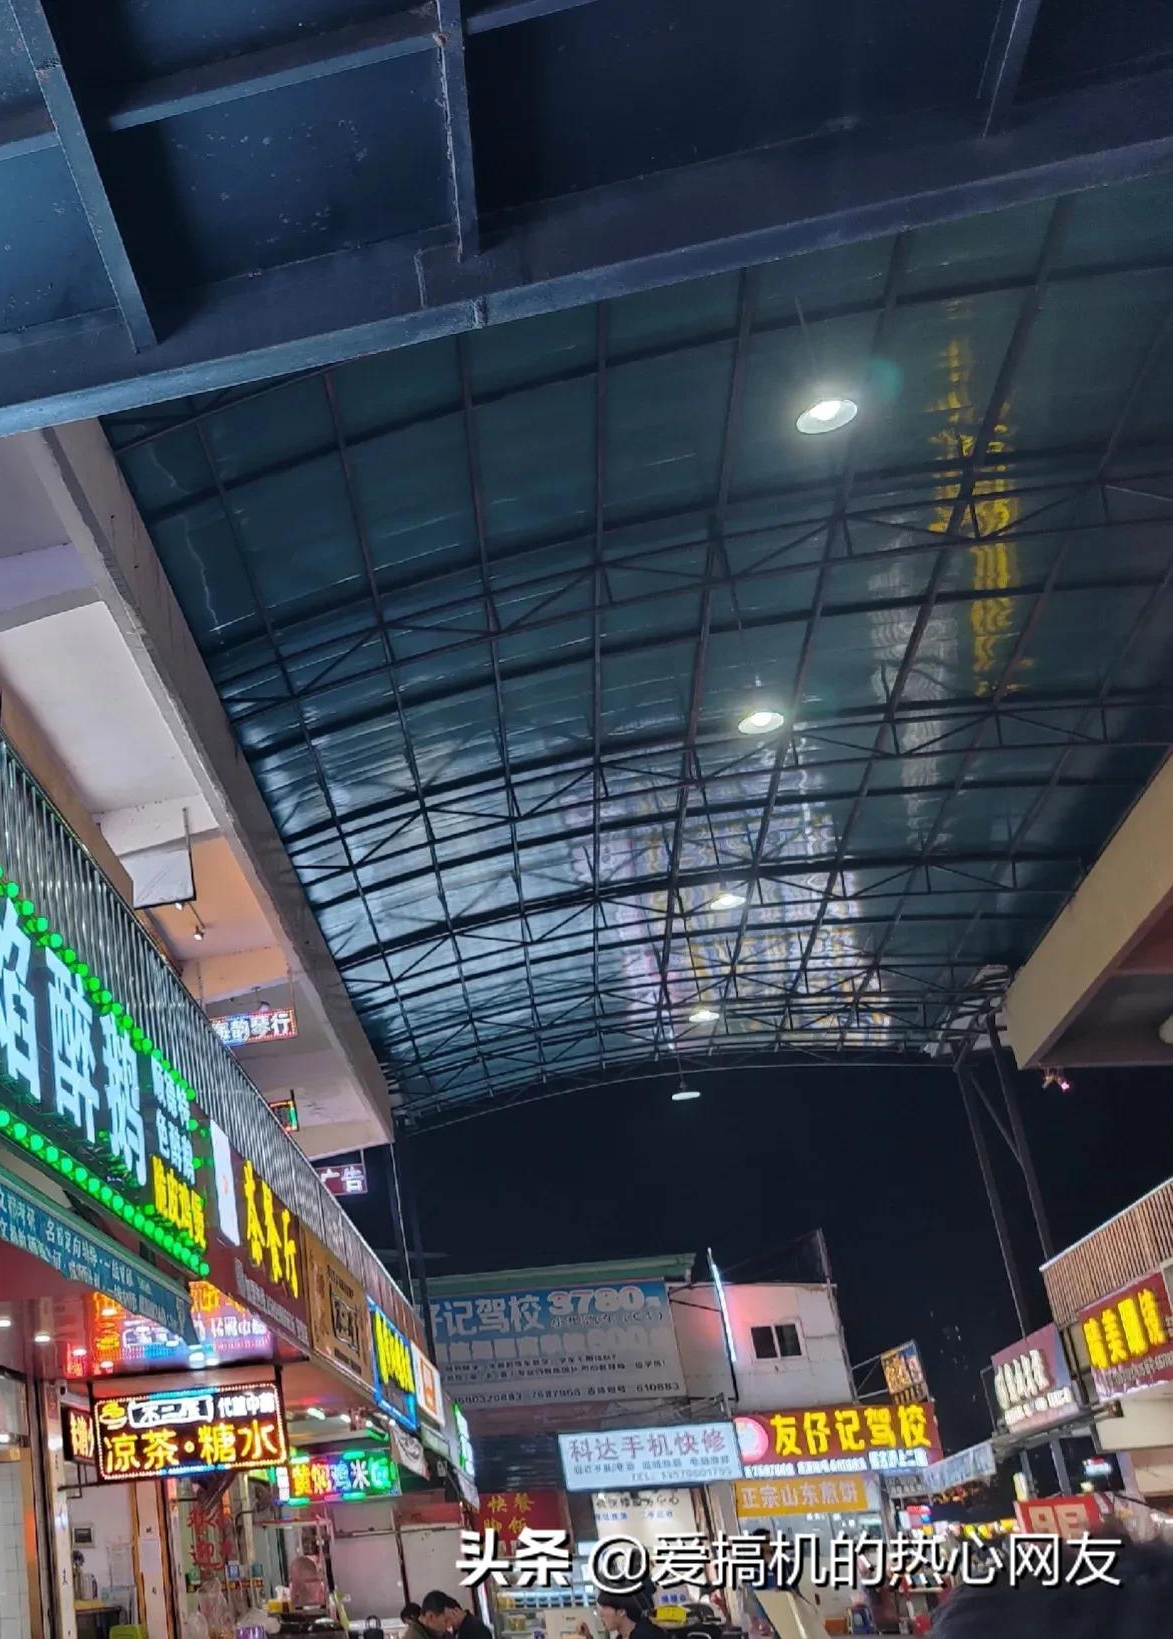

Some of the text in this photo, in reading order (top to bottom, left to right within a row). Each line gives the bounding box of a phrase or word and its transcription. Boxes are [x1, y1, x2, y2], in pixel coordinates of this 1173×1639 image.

[569, 1427, 727, 1462] 科达手机快修
[770, 1403, 932, 1457] 友仔记驾校
[740, 1480, 859, 1509] 正宗山东煎饼
